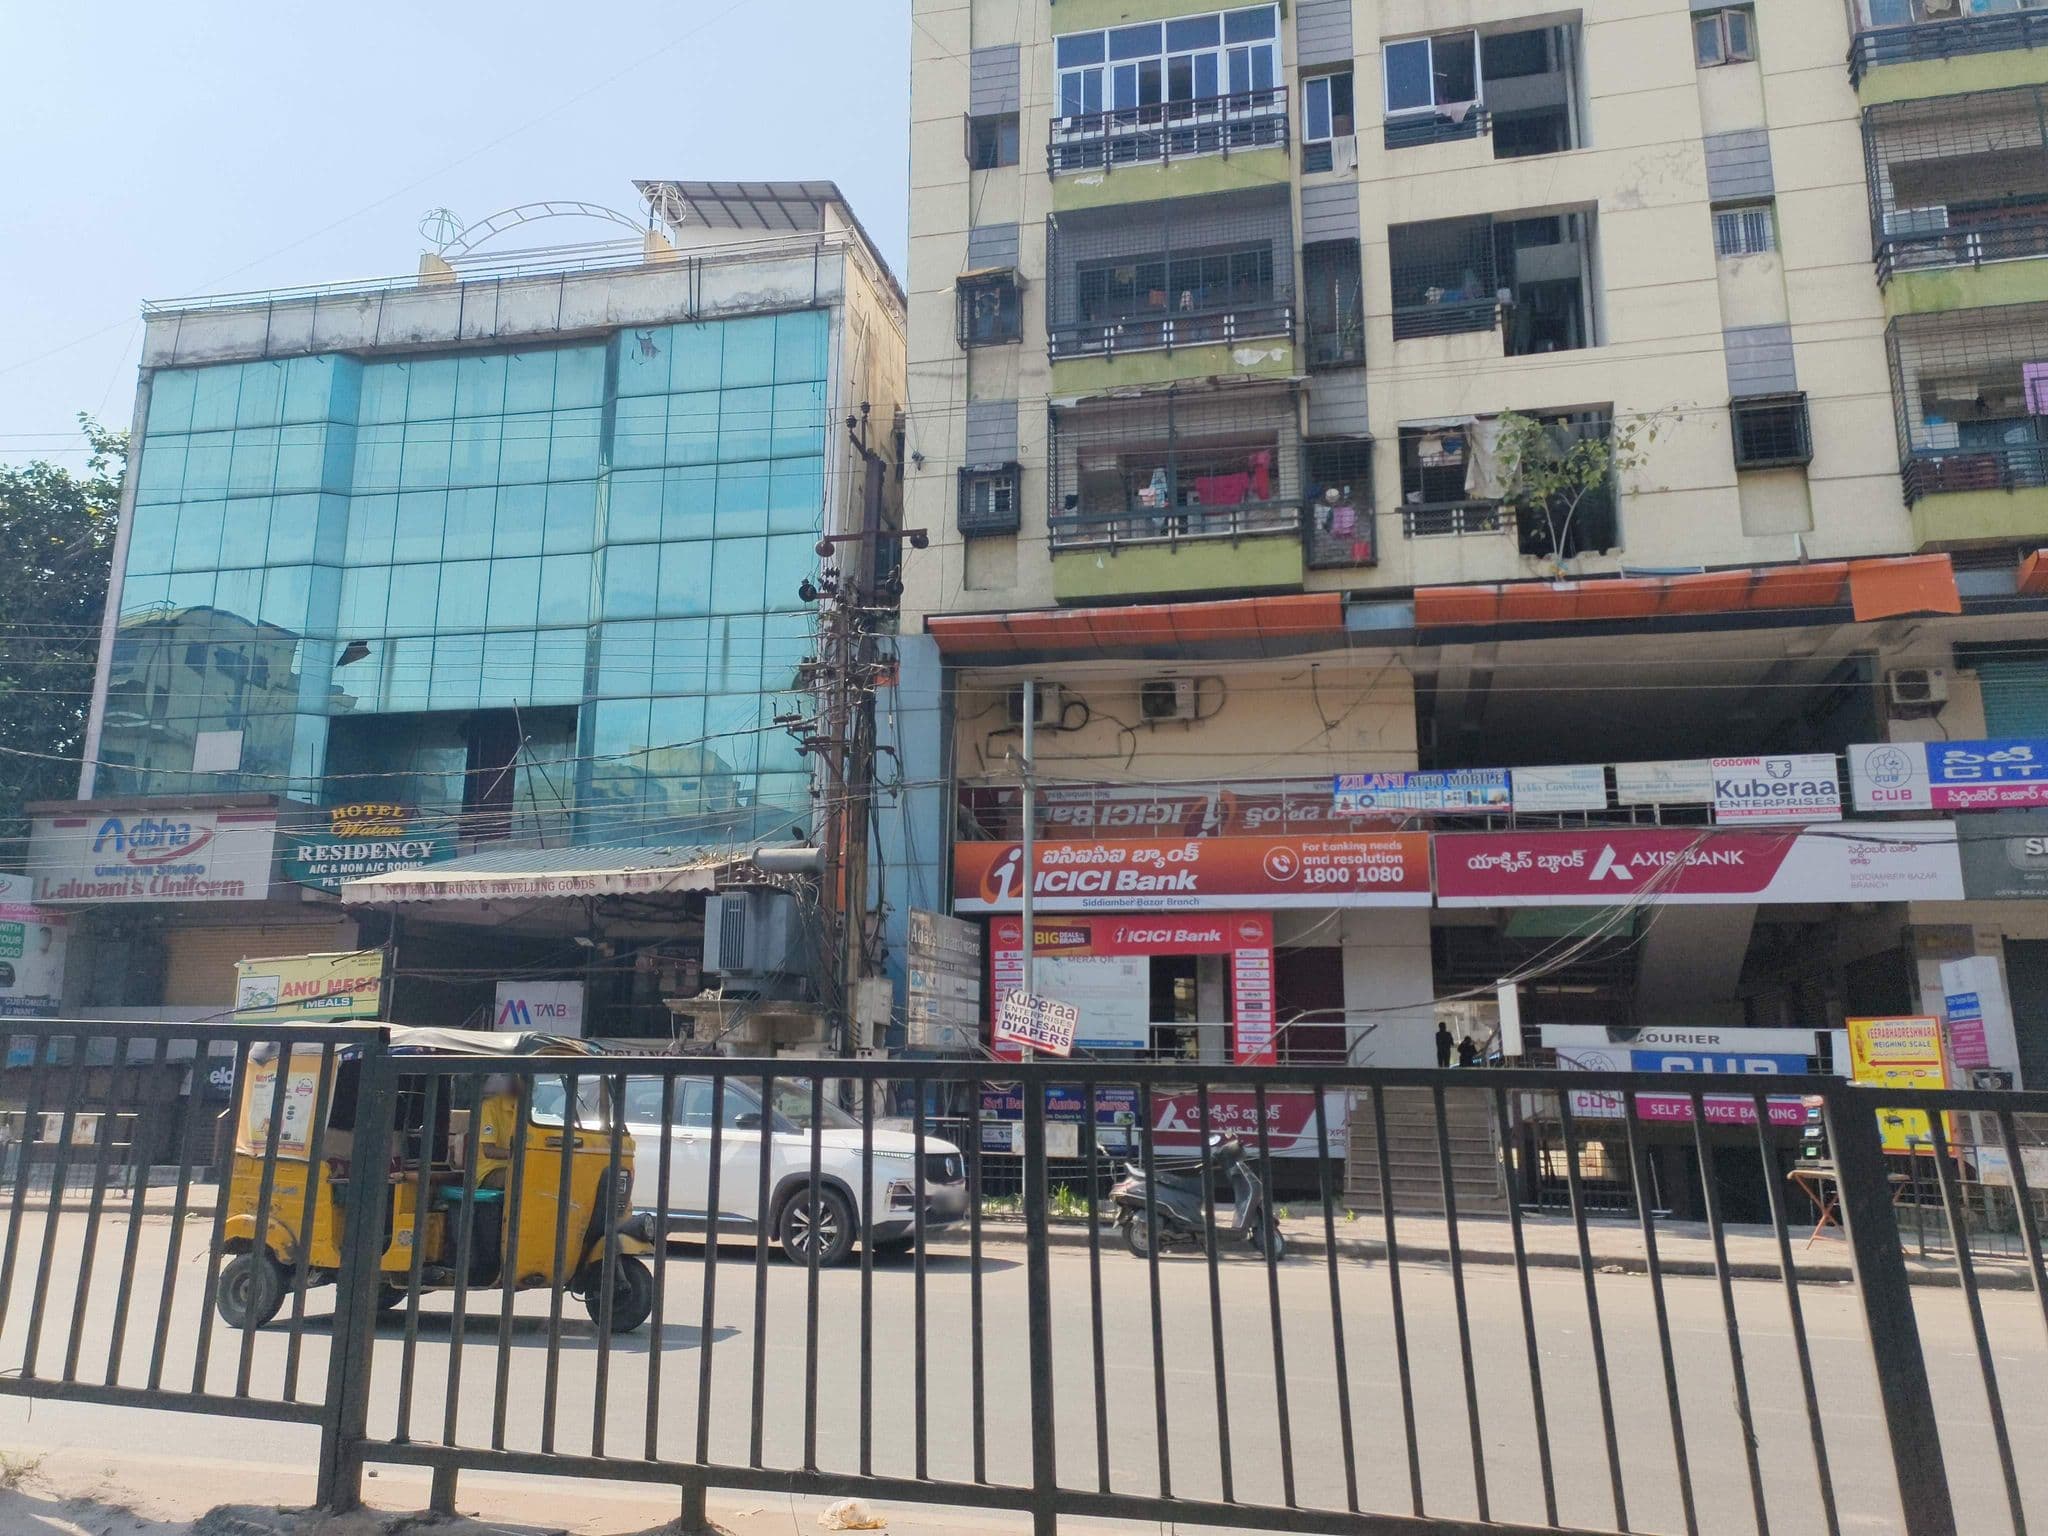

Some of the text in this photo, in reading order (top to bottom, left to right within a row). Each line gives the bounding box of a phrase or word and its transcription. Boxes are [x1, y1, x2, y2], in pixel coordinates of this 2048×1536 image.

[1712, 758, 1760, 768] GODOWN
[1944, 765, 2048, 779] CIT
[1338, 773, 1405, 790] ZILANI
[1408, 775, 1444, 787] AUTO
[1449, 774, 1504, 786] MOBILE
[1716, 779, 1837, 798] Kuberaa
[1719, 797, 1836, 808] ENTERPRISES
[1872, 790, 1912, 801] CUB
[331, 803, 405, 819] HOTEL
[92, 817, 191, 852] Adbha
[297, 841, 435, 861] RESIDENCY
[1302, 841, 1402, 853] For banking needs
[1303, 852, 1403, 865] and resolution
[1631, 850, 1745, 866] AXIS BANK
[309, 864, 328, 874] A/C
[330, 863, 337, 873] &
[340, 863, 363, 873] NON
[366, 862, 384, 872] A/C
[1303, 867, 1404, 883] 1800 1080
[150, 875, 245, 897] Uniform
[441, 884, 478, 895] RUNK
[491, 881, 555, 893] TRAVELLING
[558, 879, 596, 890] GOODS
[1034, 870, 1112, 892] ICICI
[1115, 869, 1198, 891] Bank
[1082, 897, 1200, 907] Siddiamber Bazar Branch
[1035, 932, 1059, 944] BIG
[1127, 930, 1171, 942] ICICI
[1175, 929, 1221, 942] Bank
[0, 947, 20, 956] OGO
[281, 976, 378, 997] ANU MESS
[306, 997, 350, 1008] MEALS
[534, 1004, 567, 1017] TMB
[1005, 987, 1076, 1021] Kuberaa
[1004, 1003, 1073, 1029] ENTERPRISES
[1004, 1011, 1070, 1036] WHOLESALE
[1001, 1020, 1070, 1047] DIAPERS
[1909, 1040, 1932, 1048] SCALE
[1047, 1098, 1080, 1111] Auto
[1651, 1103, 1797, 1120] SELF SRVICE BAKING
